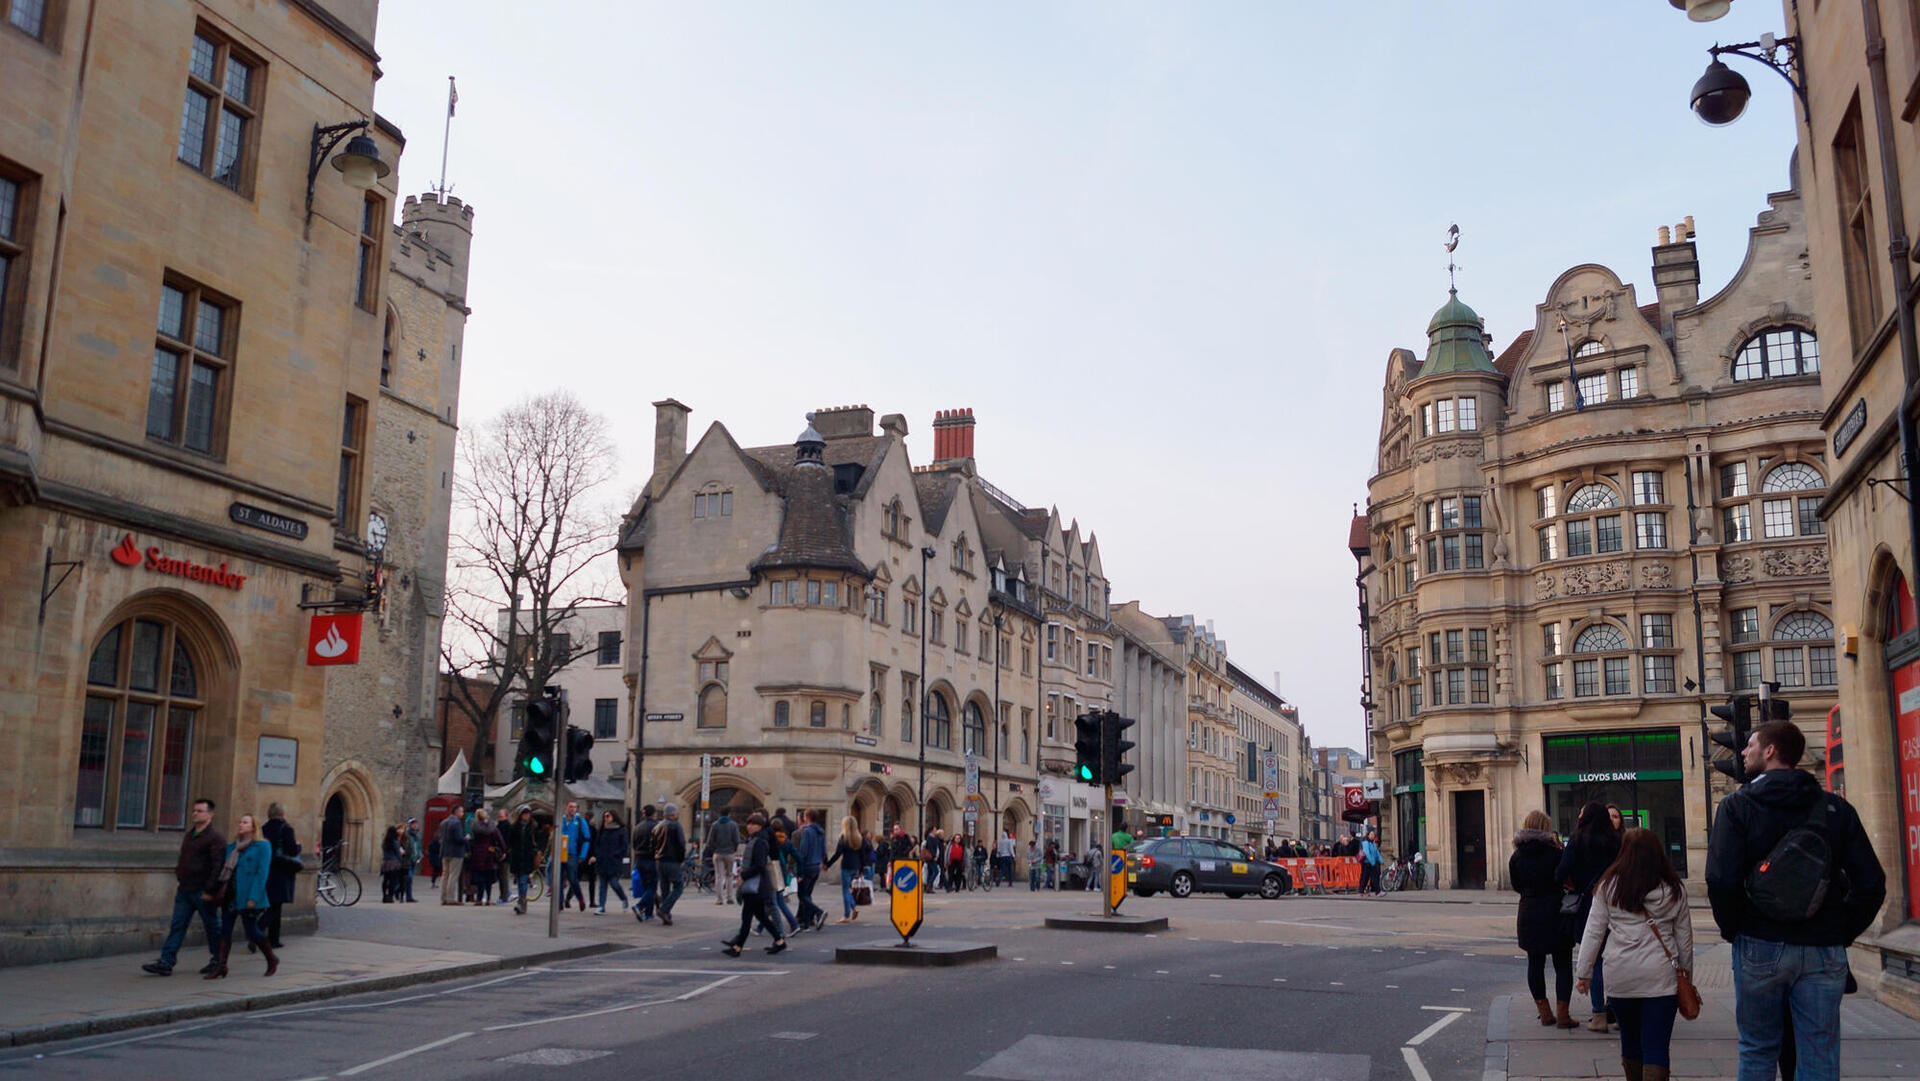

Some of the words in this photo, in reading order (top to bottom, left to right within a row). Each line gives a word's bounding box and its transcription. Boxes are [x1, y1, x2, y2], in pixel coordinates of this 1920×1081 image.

[239, 507, 250, 519] ST
[259, 514, 302, 534] ALDATES
[145, 547, 247, 590] Santander
[1579, 773, 1610, 782] LLOYDS
[1612, 772, 1637, 781] BANK
